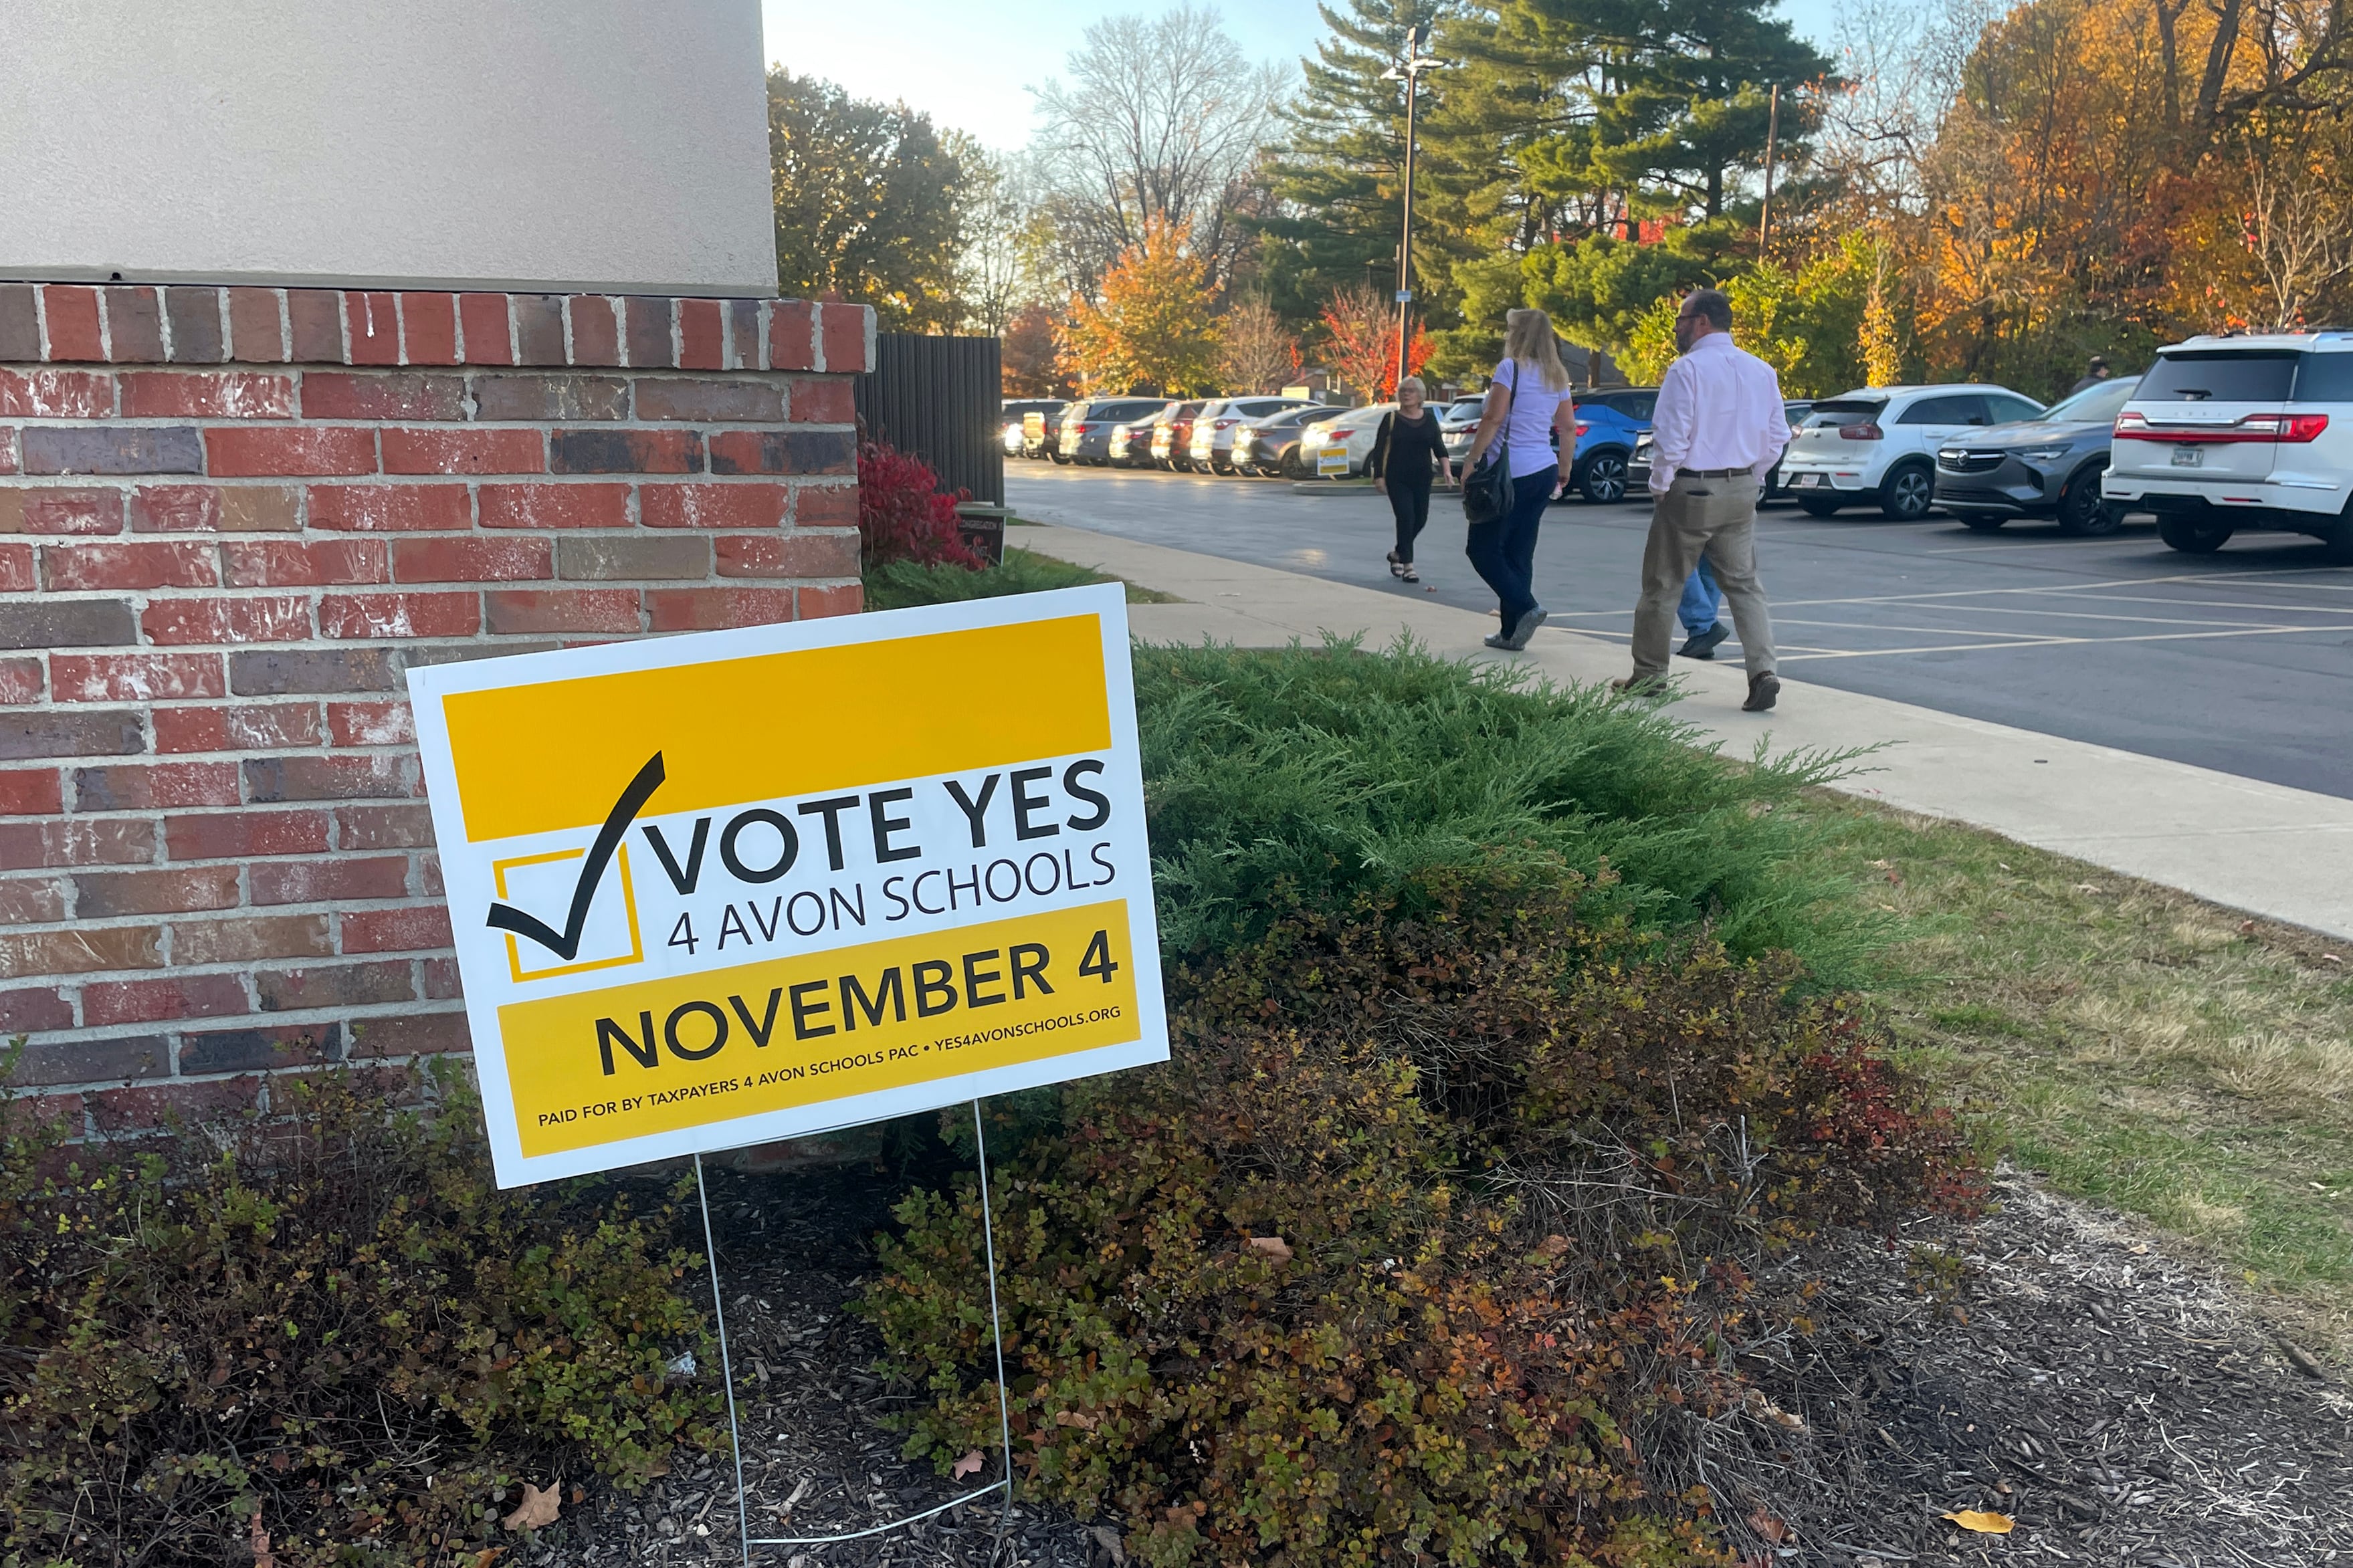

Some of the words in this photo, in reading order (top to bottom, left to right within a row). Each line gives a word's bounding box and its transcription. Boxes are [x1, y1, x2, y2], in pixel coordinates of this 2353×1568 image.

[641, 787, 922, 895] VOTE
[942, 759, 1111, 849] YES
[668, 912, 699, 955] 4
[718, 883, 865, 950] AVON
[883, 842, 1115, 921] SCHOOLS
[538, 1109, 577, 1127] PAID
[583, 1101, 617, 1119] FOR
[622, 1096, 643, 1111] BY
[647, 1079, 738, 1106] TAXPAYERS
[744, 1076, 753, 1088] 4
[758, 1066, 805, 1086] AVON
[810, 1051, 884, 1076] SCHOOLS
[889, 1044, 918, 1060] PAC
[934, 1006, 1120, 1051] YES4AVONSCHOOLS.ORG
[595, 943, 1055, 1076] NOVEMBER
[1078, 929, 1118, 984] 4
